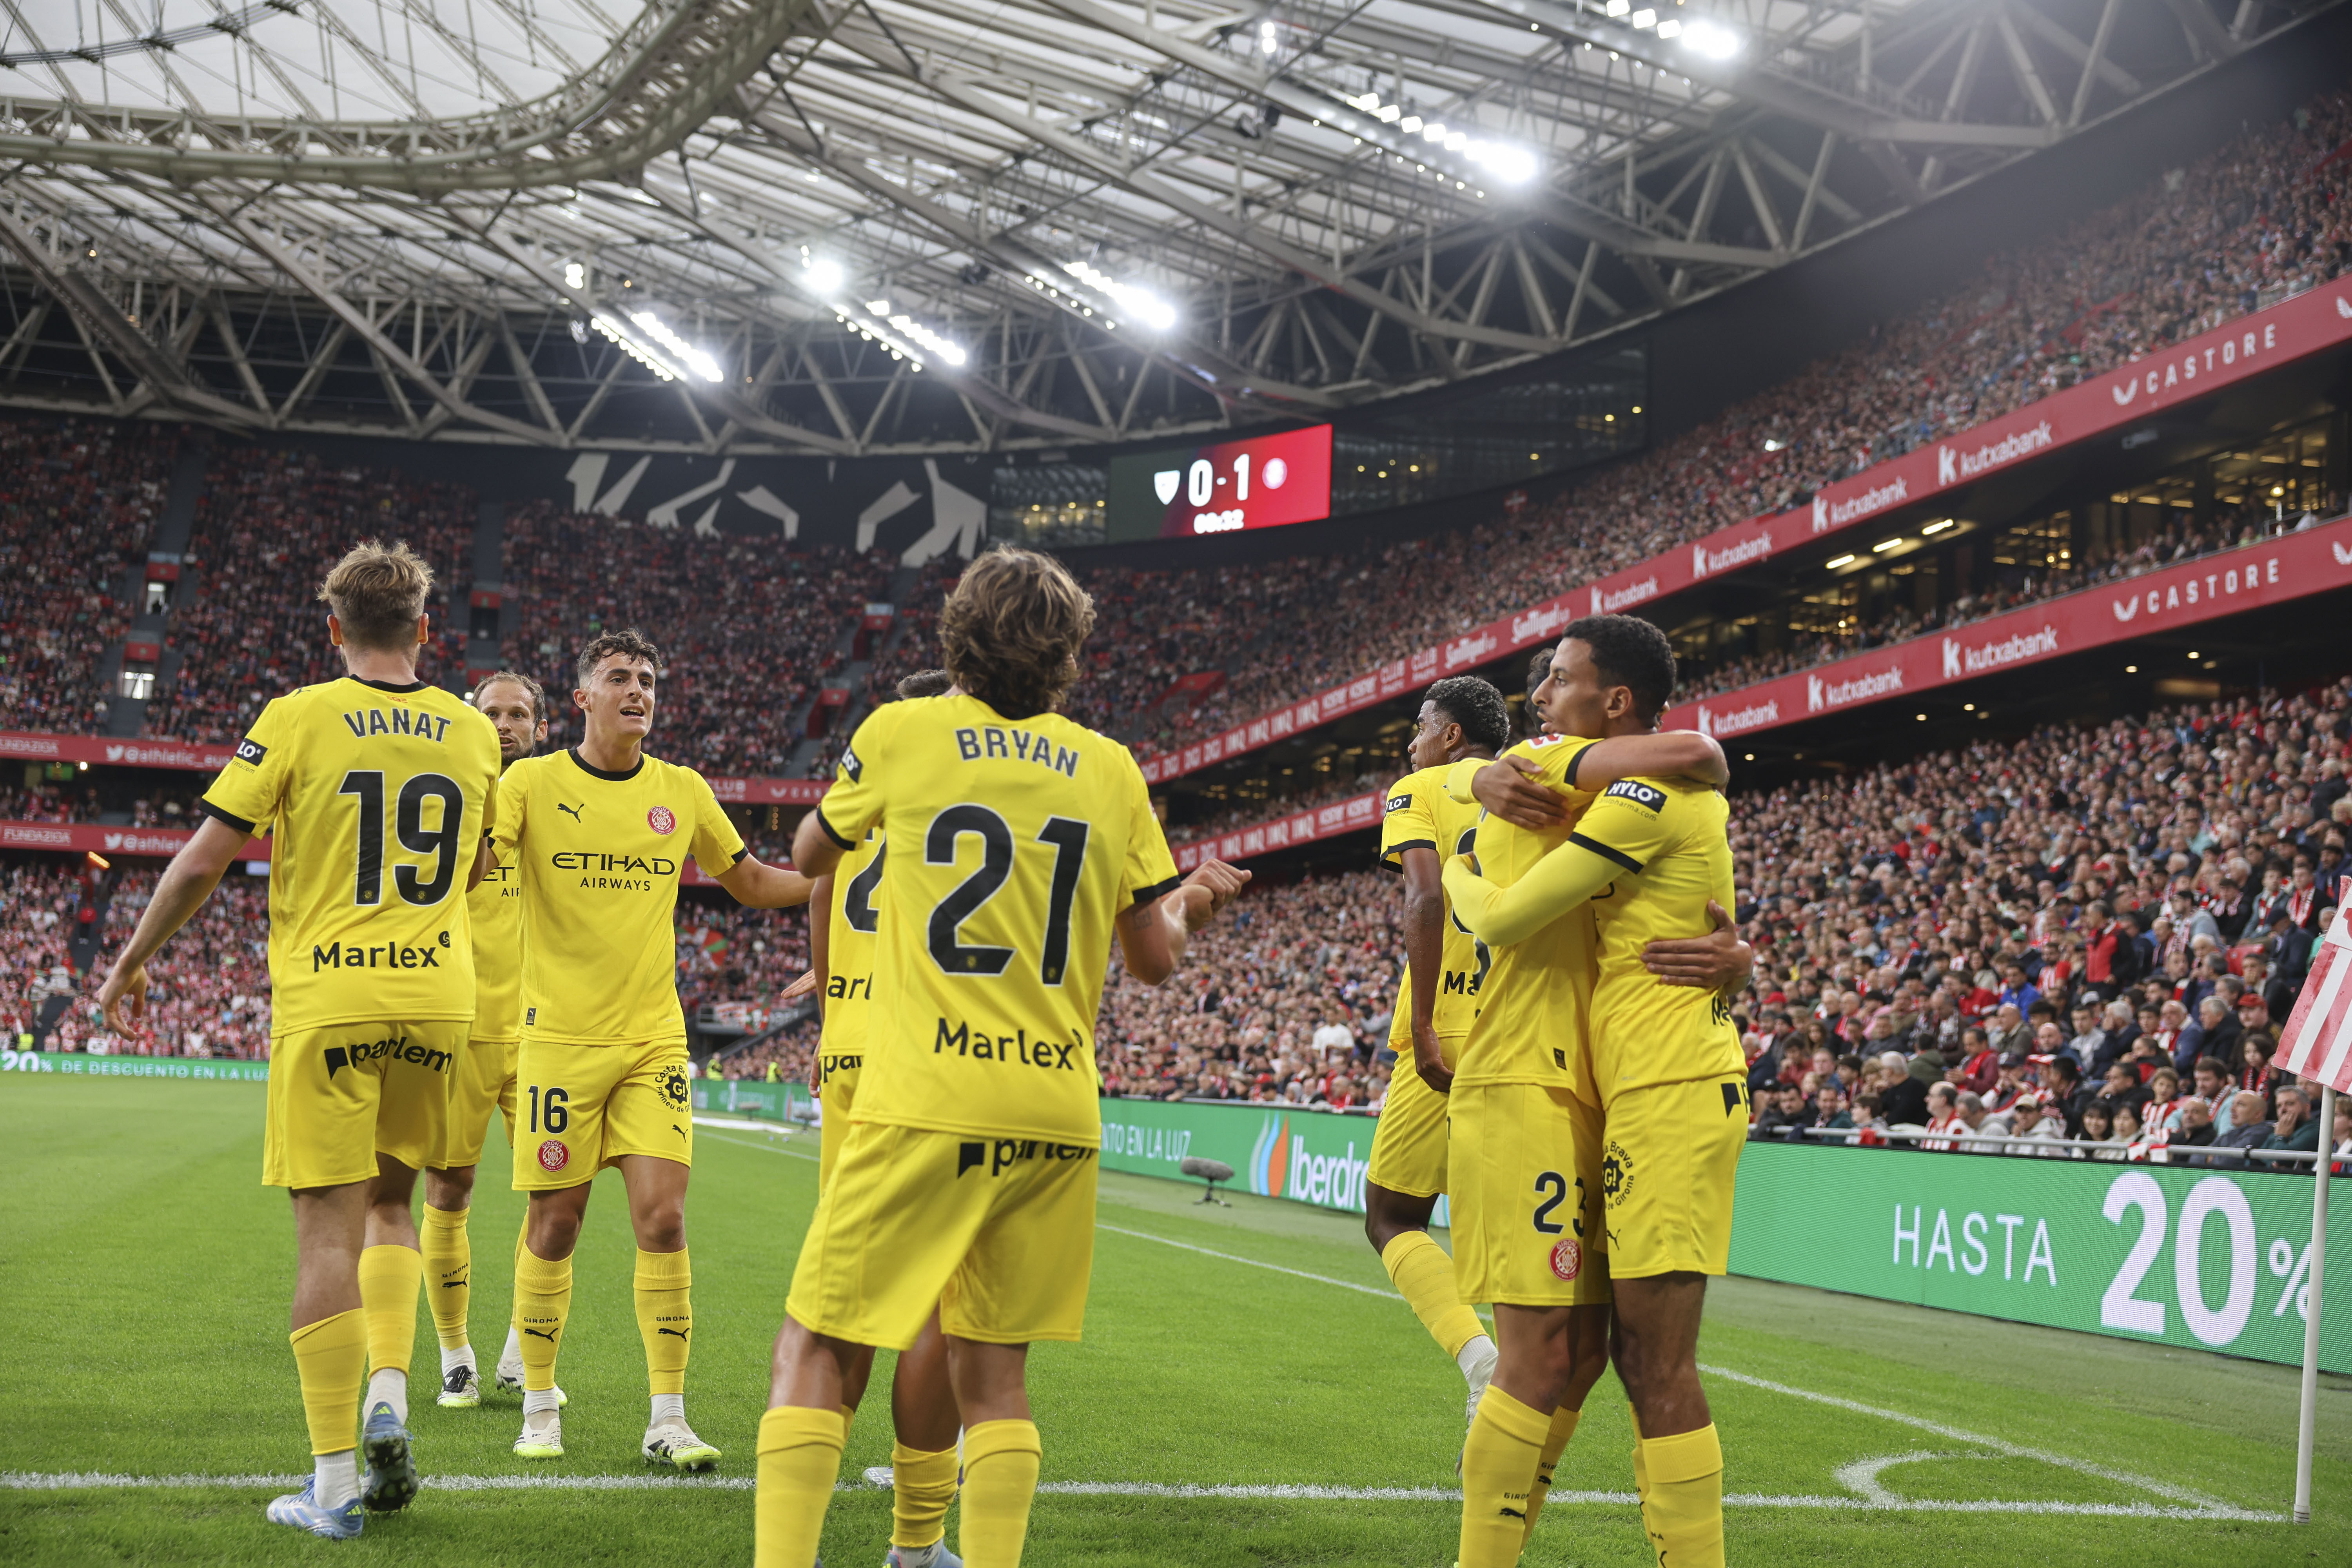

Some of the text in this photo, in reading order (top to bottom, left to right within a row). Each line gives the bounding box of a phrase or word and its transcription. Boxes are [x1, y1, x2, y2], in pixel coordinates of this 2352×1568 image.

[2146, 323, 2276, 394] CASTORE
[1961, 420, 2052, 477] kutxabank
[1831, 475, 1908, 525] kutxabank
[1708, 530, 1772, 572] kutxabank
[1604, 575, 1659, 612] kutxabank
[2147, 558, 2280, 613] CASTORE
[1965, 624, 2058, 672] kutxabank
[1826, 665, 1904, 707] kutxabank
[343, 708, 452, 743] VANAT
[1713, 699, 1779, 735] kutxabank
[955, 728, 1079, 779] BRYAN
[337, 770, 464, 907] 19
[552, 852, 675, 875] ETIHAD
[580, 877, 651, 891] AIRWAYS
[924, 802, 1091, 987] 21
[313, 941, 440, 973] Marlex
[350, 1036, 452, 1074] parlem
[934, 1017, 1074, 1071] Marlex
[62, 1060, 83, 1074] DE
[89, 1060, 189, 1078] DESCUENTO
[194, 1066, 215, 1079] EN
[220, 1067, 240, 1080] LA
[655, 1065, 676, 1083] Costa
[527, 1085, 569, 1134] 16
[656, 1087, 675, 1110] Pirineu
[1127, 1125, 1144, 1156] EN
[1146, 1127, 1163, 1159] LA
[1165, 1129, 1191, 1161] LUZ
[1610, 1141, 1633, 1169] Brava
[1615, 1175, 1634, 1206] Girona
[1893, 1204, 2058, 1287] HASTA
[442, 1262, 468, 1277] GIRONA
